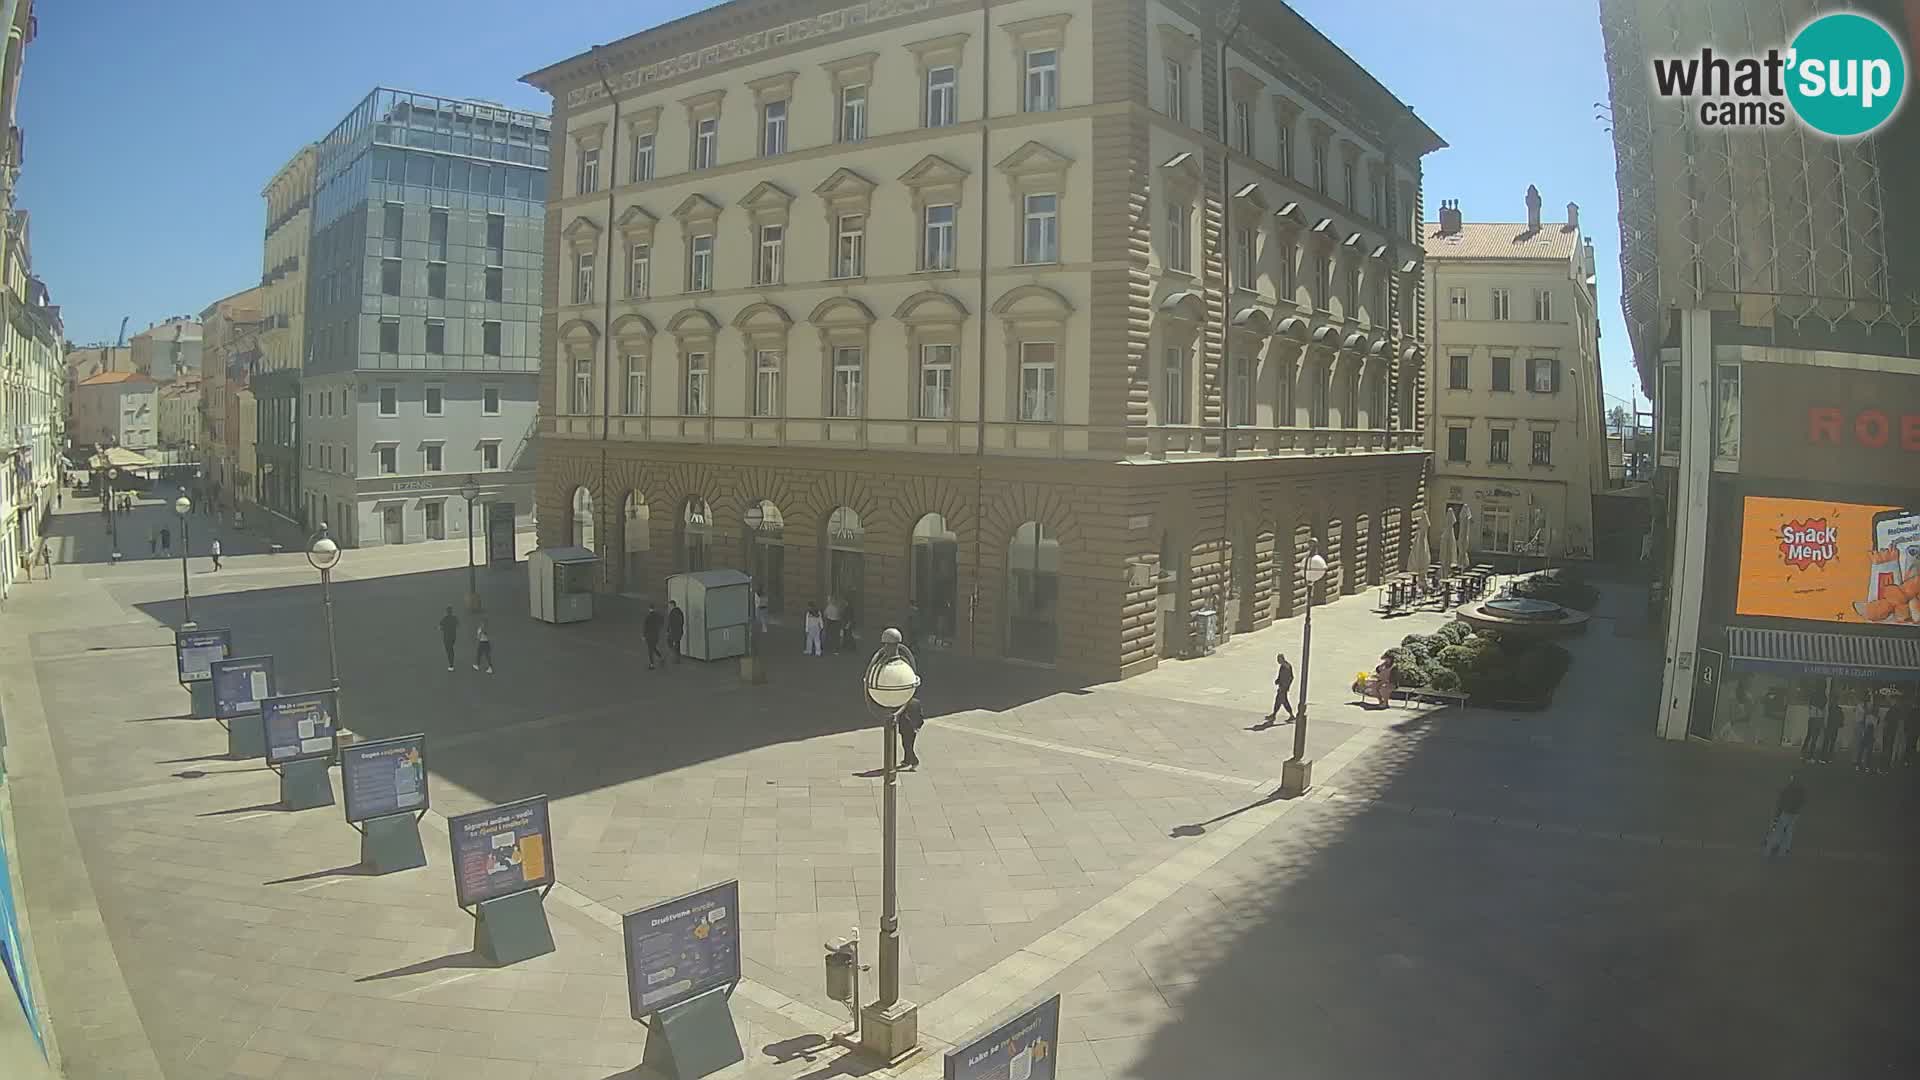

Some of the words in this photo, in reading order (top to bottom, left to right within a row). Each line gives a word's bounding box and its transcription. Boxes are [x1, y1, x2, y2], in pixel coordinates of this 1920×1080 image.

[392, 480, 432, 491] TEZENIS
[1783, 526, 1836, 545] Snack
[651, 908, 691, 928] Društvene
[968, 1051, 989, 1067] Kako
